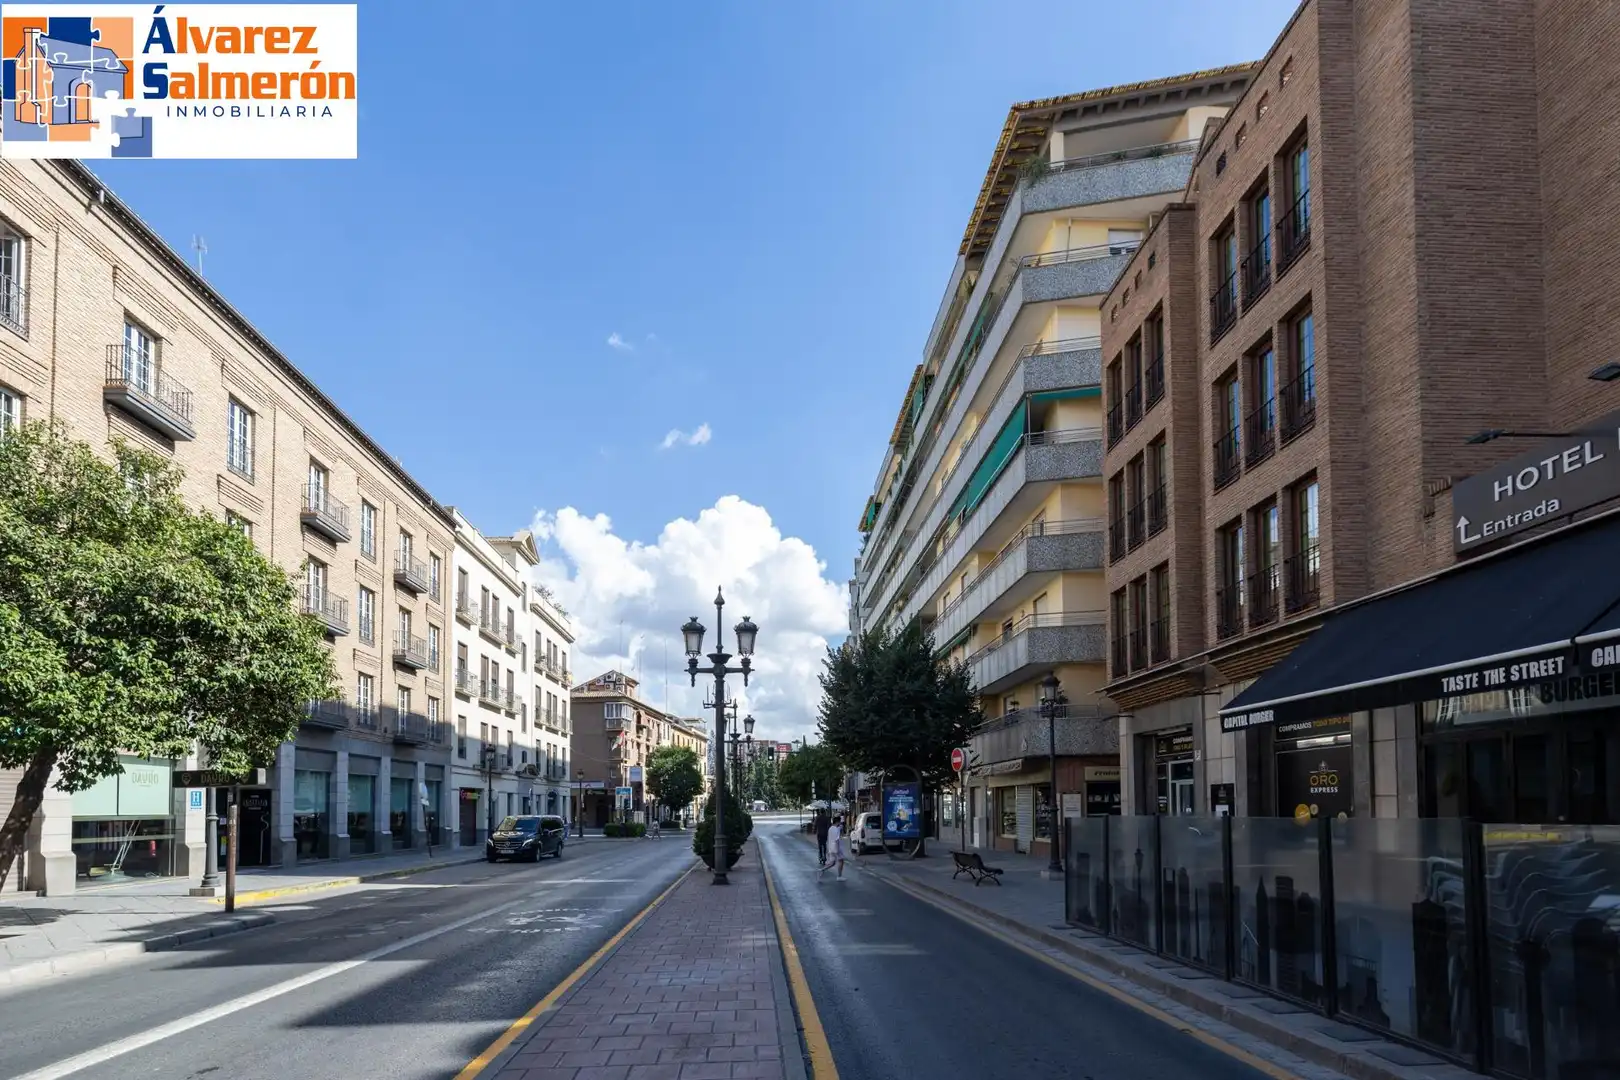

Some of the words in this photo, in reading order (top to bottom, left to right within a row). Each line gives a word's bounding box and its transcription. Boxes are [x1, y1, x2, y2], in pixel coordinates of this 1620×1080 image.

[1493, 440, 1604, 502] HOTEL
[1483, 498, 1560, 537] Entrada
[1441, 672, 1479, 693] TASTE
[1483, 667, 1506, 686] THE
[1510, 656, 1565, 682] STREET
[1223, 714, 1248, 729] CAPITAL
[1249, 710, 1274, 725] BURGER
[1279, 721, 1312, 732] COMPRAMOS
[1309, 774, 1338, 786] ORO
[1310, 786, 1339, 794] EXPRESS
